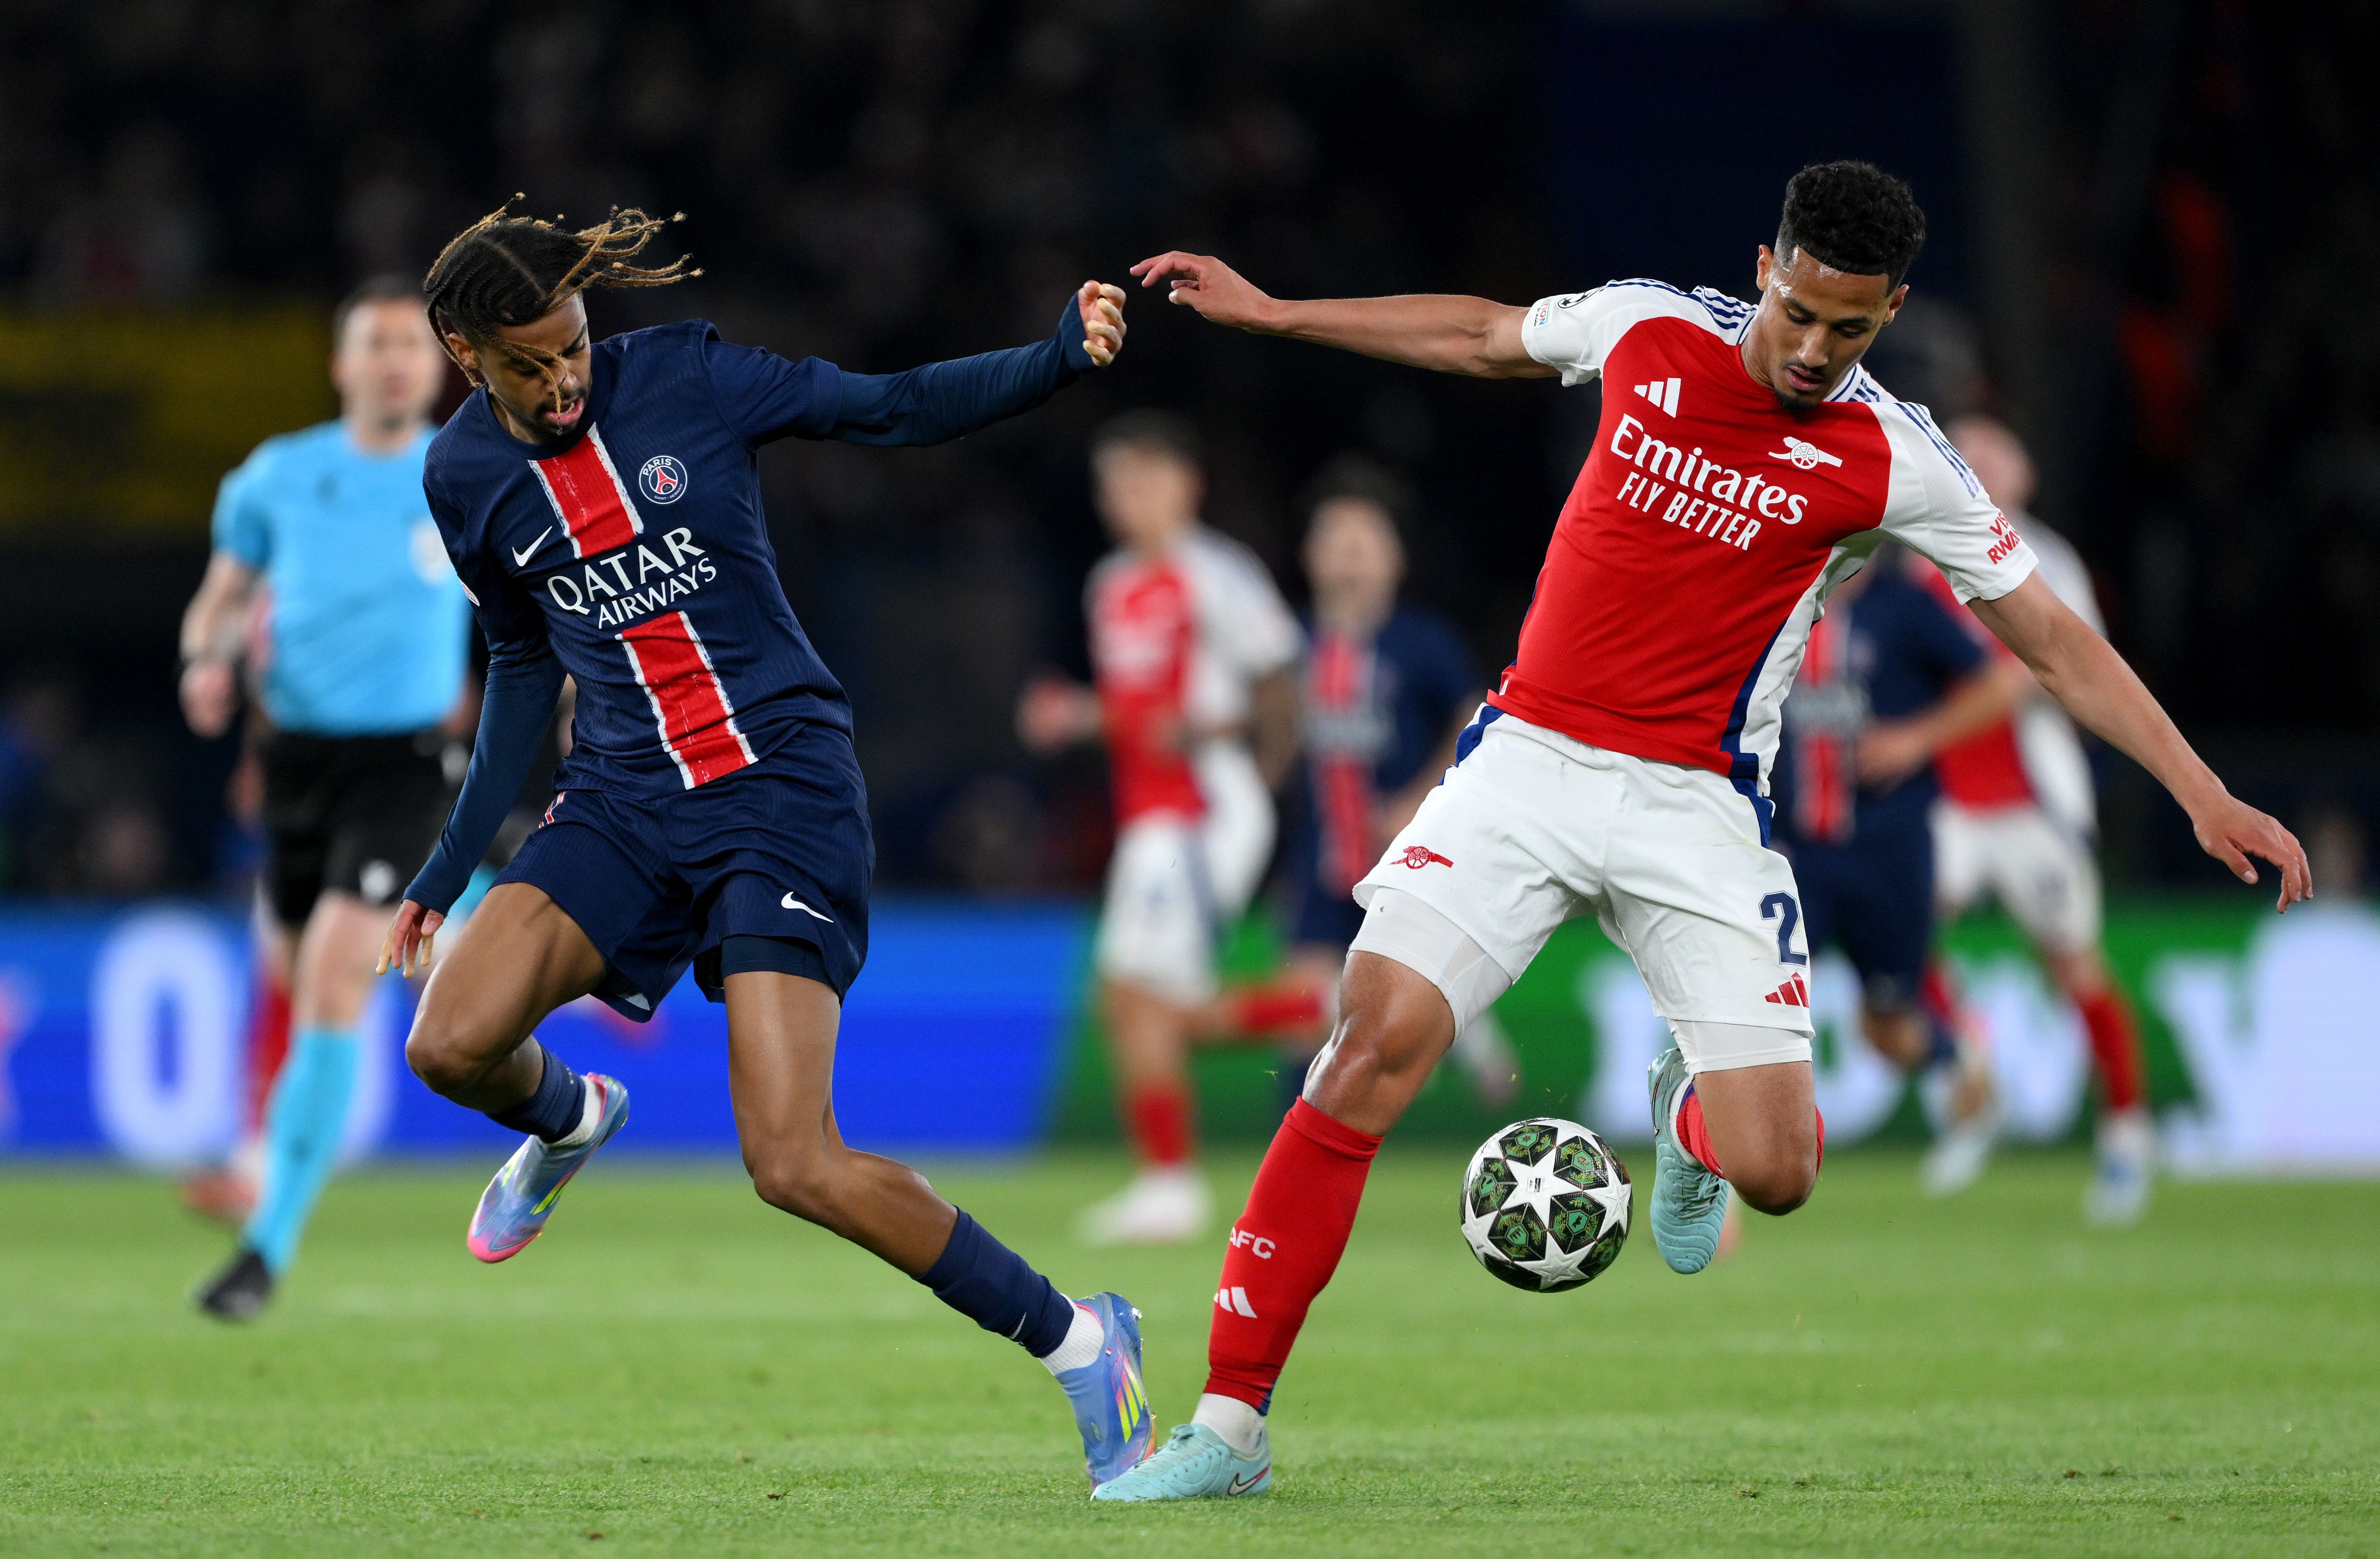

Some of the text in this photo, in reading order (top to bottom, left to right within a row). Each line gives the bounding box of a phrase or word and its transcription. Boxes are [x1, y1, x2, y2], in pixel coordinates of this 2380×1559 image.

[642, 458, 672, 475] PARIS
[1610, 413, 1808, 525] Emirates
[1616, 471, 1762, 551] FLY BETTER
[1989, 511, 2009, 536] VIS
[547, 527, 706, 615] QATAR
[598, 557, 717, 629] AIRWAYS
[1759, 890, 1808, 968] 2
[1229, 1227, 1276, 1259] AFC
